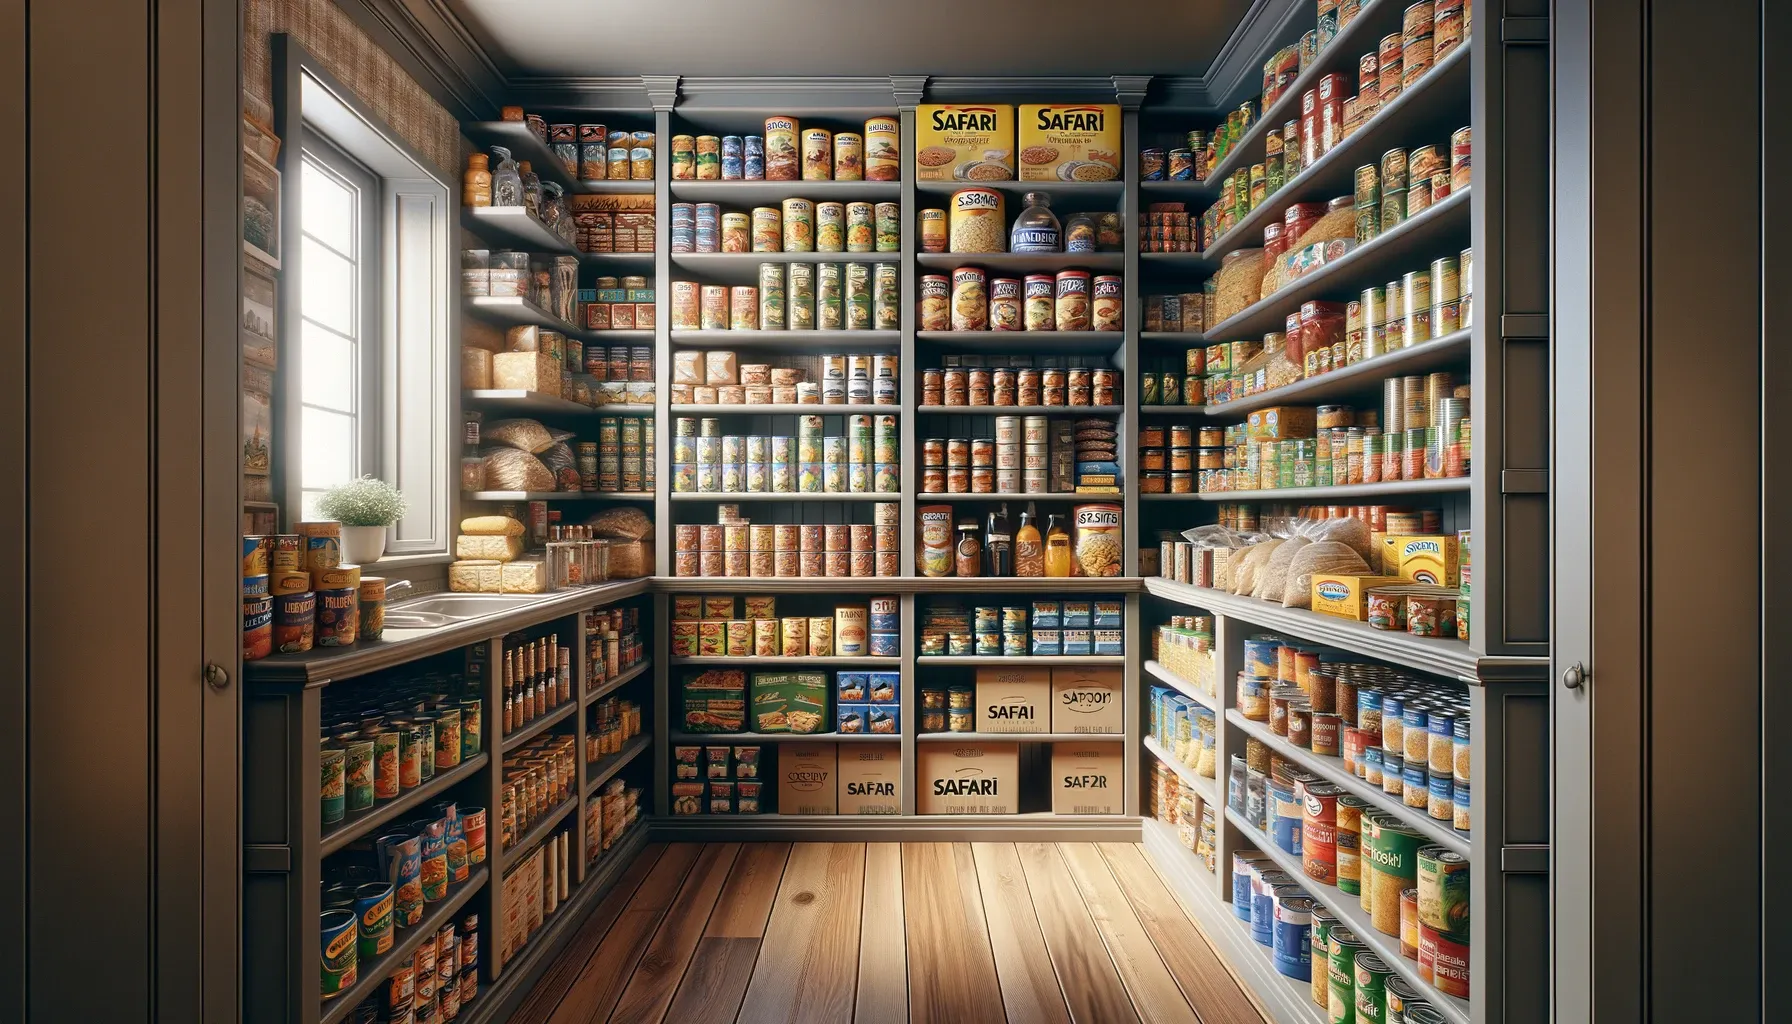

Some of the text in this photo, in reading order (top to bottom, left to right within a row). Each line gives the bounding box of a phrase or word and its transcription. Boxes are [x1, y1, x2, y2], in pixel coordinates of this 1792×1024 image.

[932, 109, 997, 131] SAFARI
[1037, 108, 1104, 132] SAFARI
[847, 782, 895, 796] SAFAR
[1064, 775, 1107, 788] SAF2R
